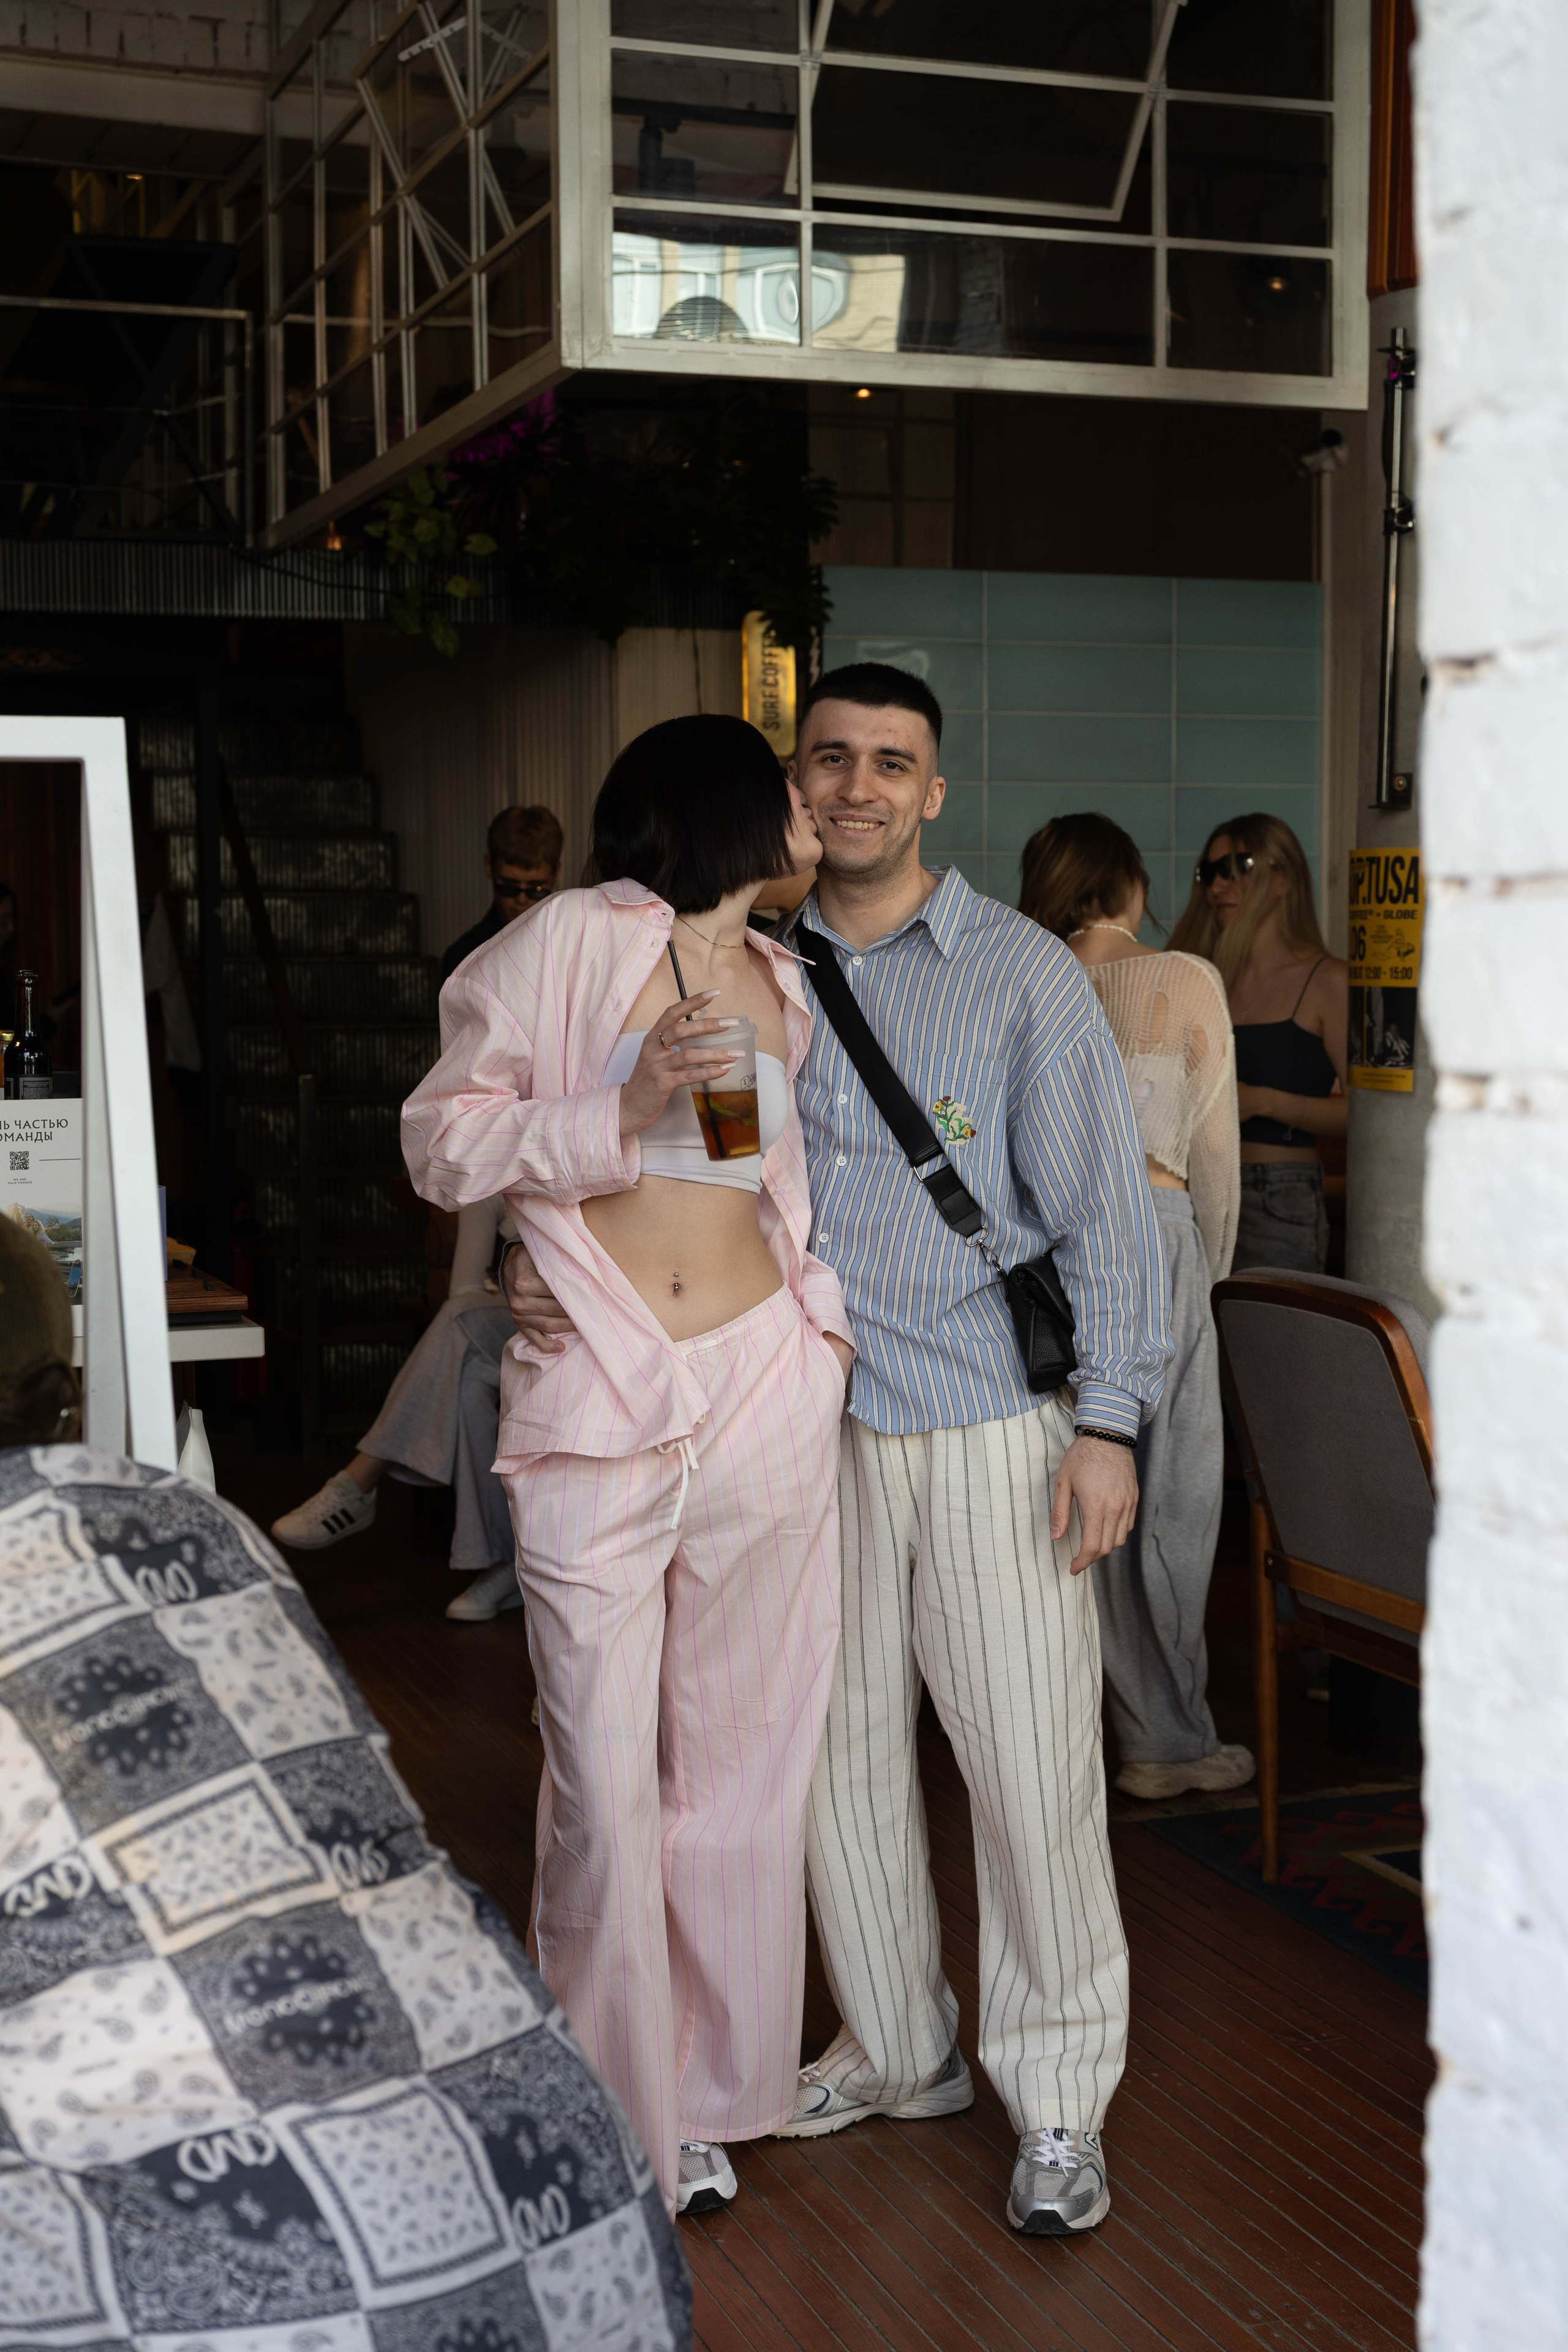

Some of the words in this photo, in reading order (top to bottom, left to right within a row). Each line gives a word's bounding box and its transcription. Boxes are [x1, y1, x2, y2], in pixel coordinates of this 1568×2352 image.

[761, 633, 779, 687] COFF
[761, 690, 779, 731] SURF
[1384, 909, 1417, 920] GLOBE
[1389, 966, 1414, 980] 15:00
[0, 1120, 10, 1129] Ь
[15, 1119, 68, 1129] ЧАСТЬЮ
